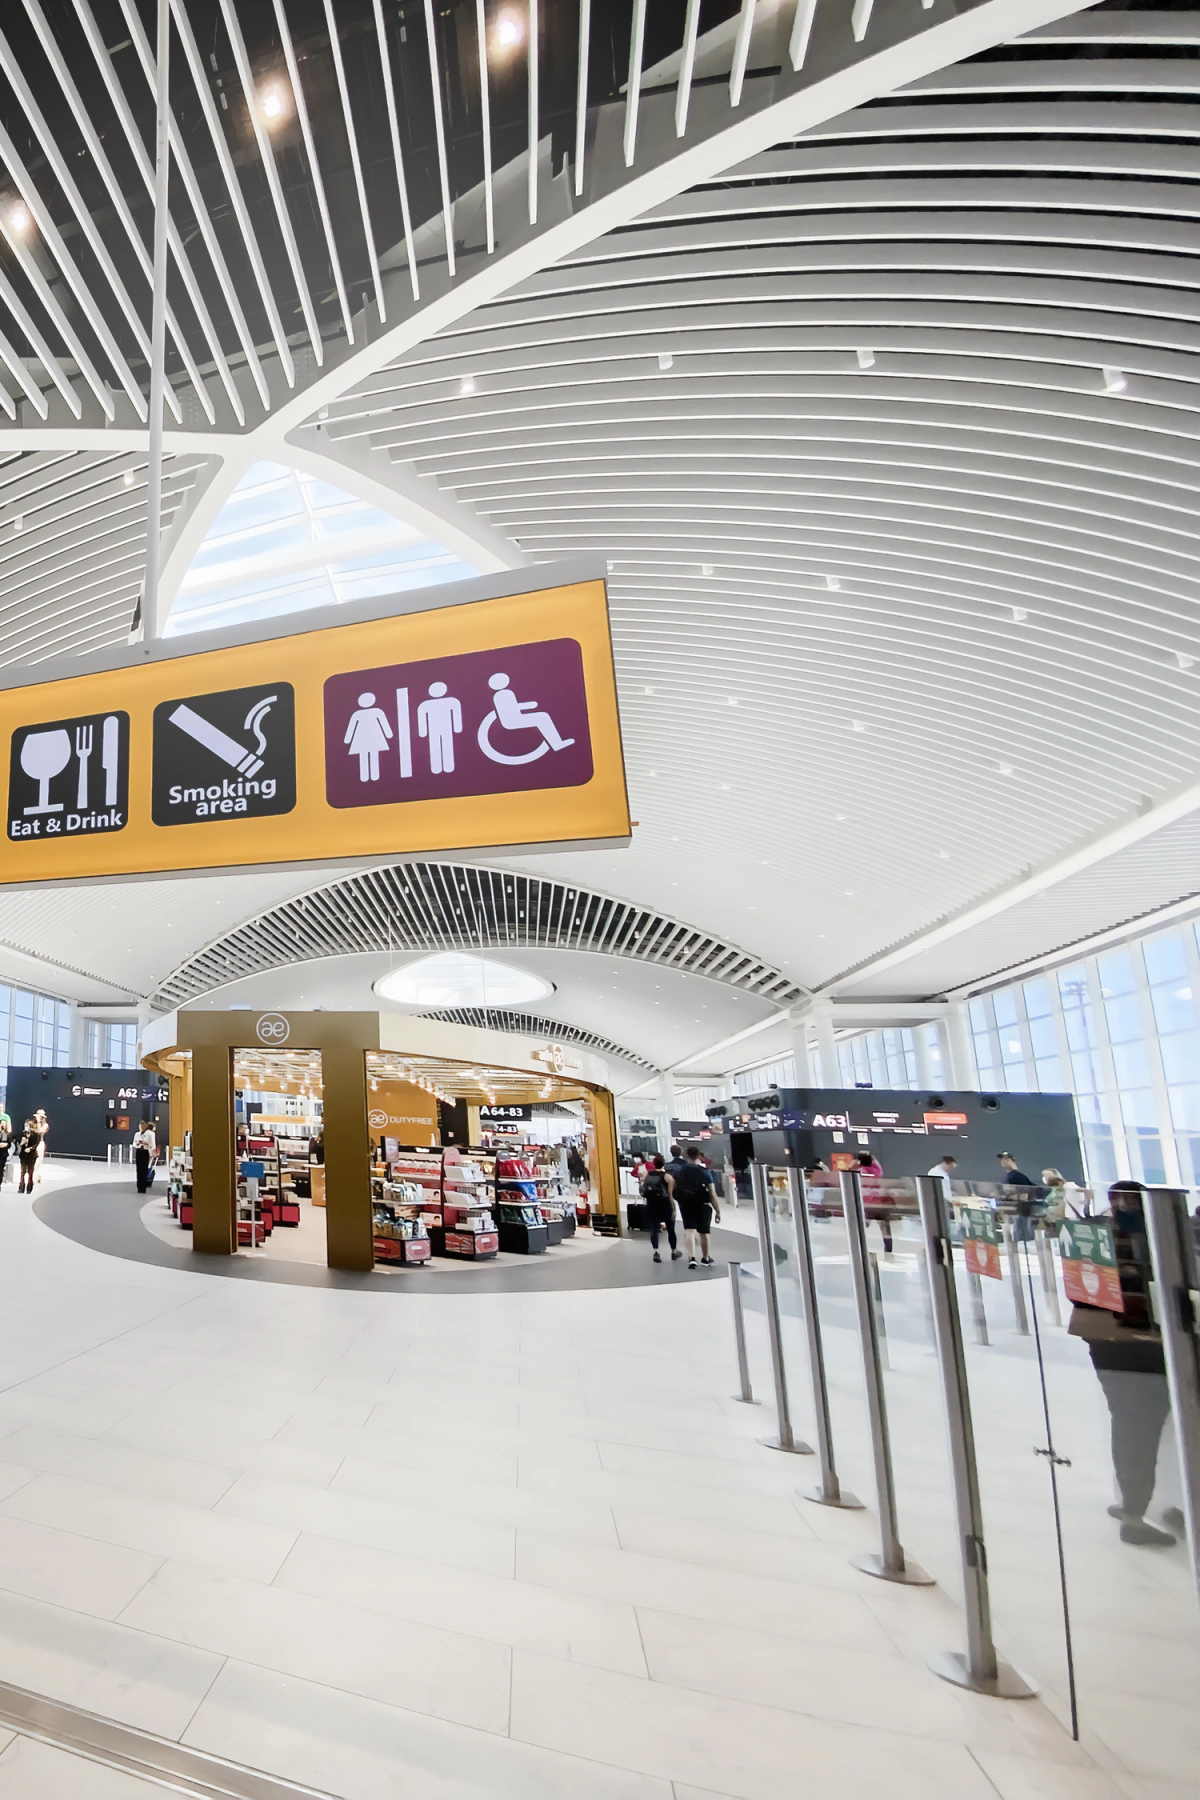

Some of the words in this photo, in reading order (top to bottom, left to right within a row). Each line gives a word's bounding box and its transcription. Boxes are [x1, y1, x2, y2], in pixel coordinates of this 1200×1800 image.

[169, 777, 277, 804] Smoking
[195, 797, 247, 816] area
[11, 818, 41, 837] Eat
[46, 817, 61, 833] &
[66, 809, 123, 832] Drink
[117, 1087, 138, 1098] A62
[812, 1113, 848, 1128] A63
